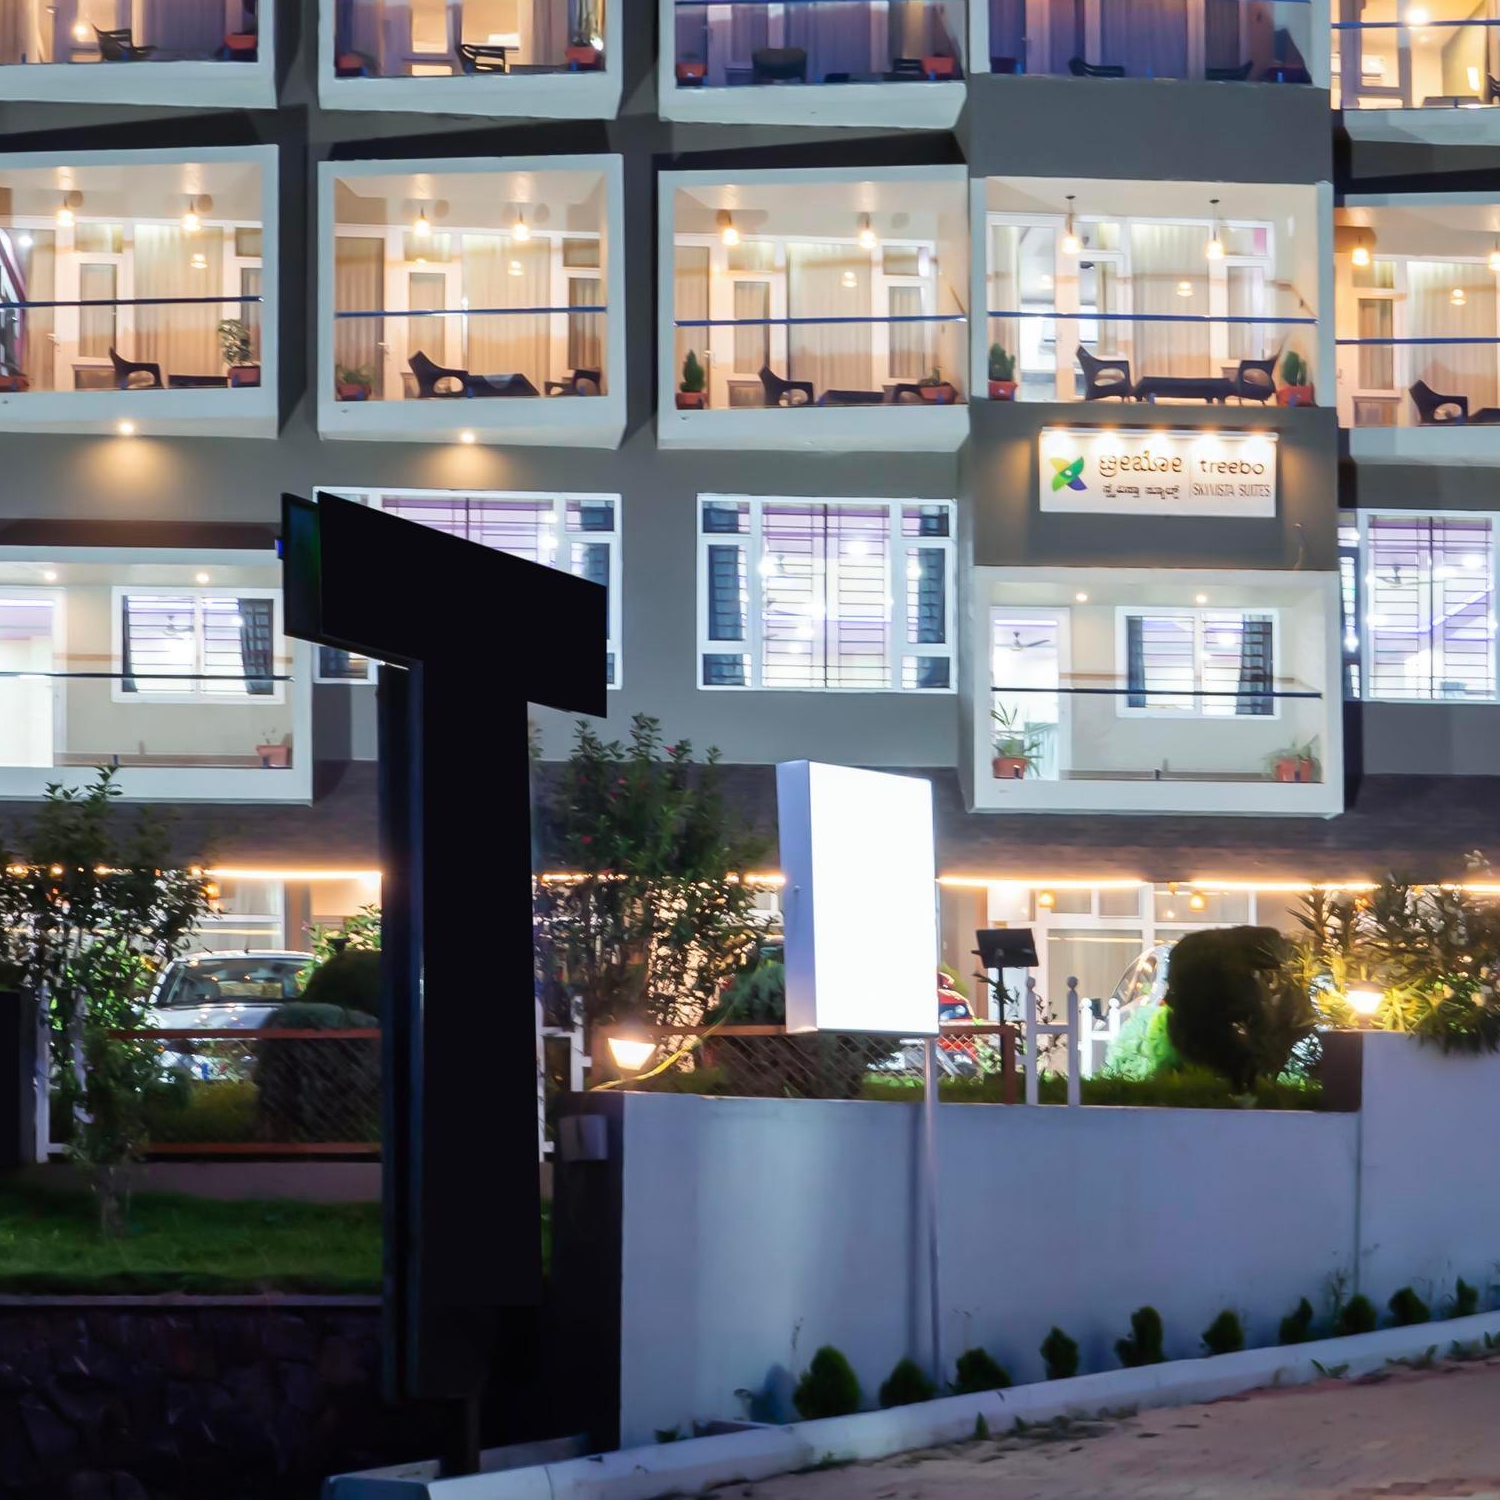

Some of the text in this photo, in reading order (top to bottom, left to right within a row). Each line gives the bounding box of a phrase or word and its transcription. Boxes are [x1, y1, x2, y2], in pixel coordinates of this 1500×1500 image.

[1199, 460, 1265, 475] treebo
[1192, 483, 1271, 497] SKYVISTA SUITES
